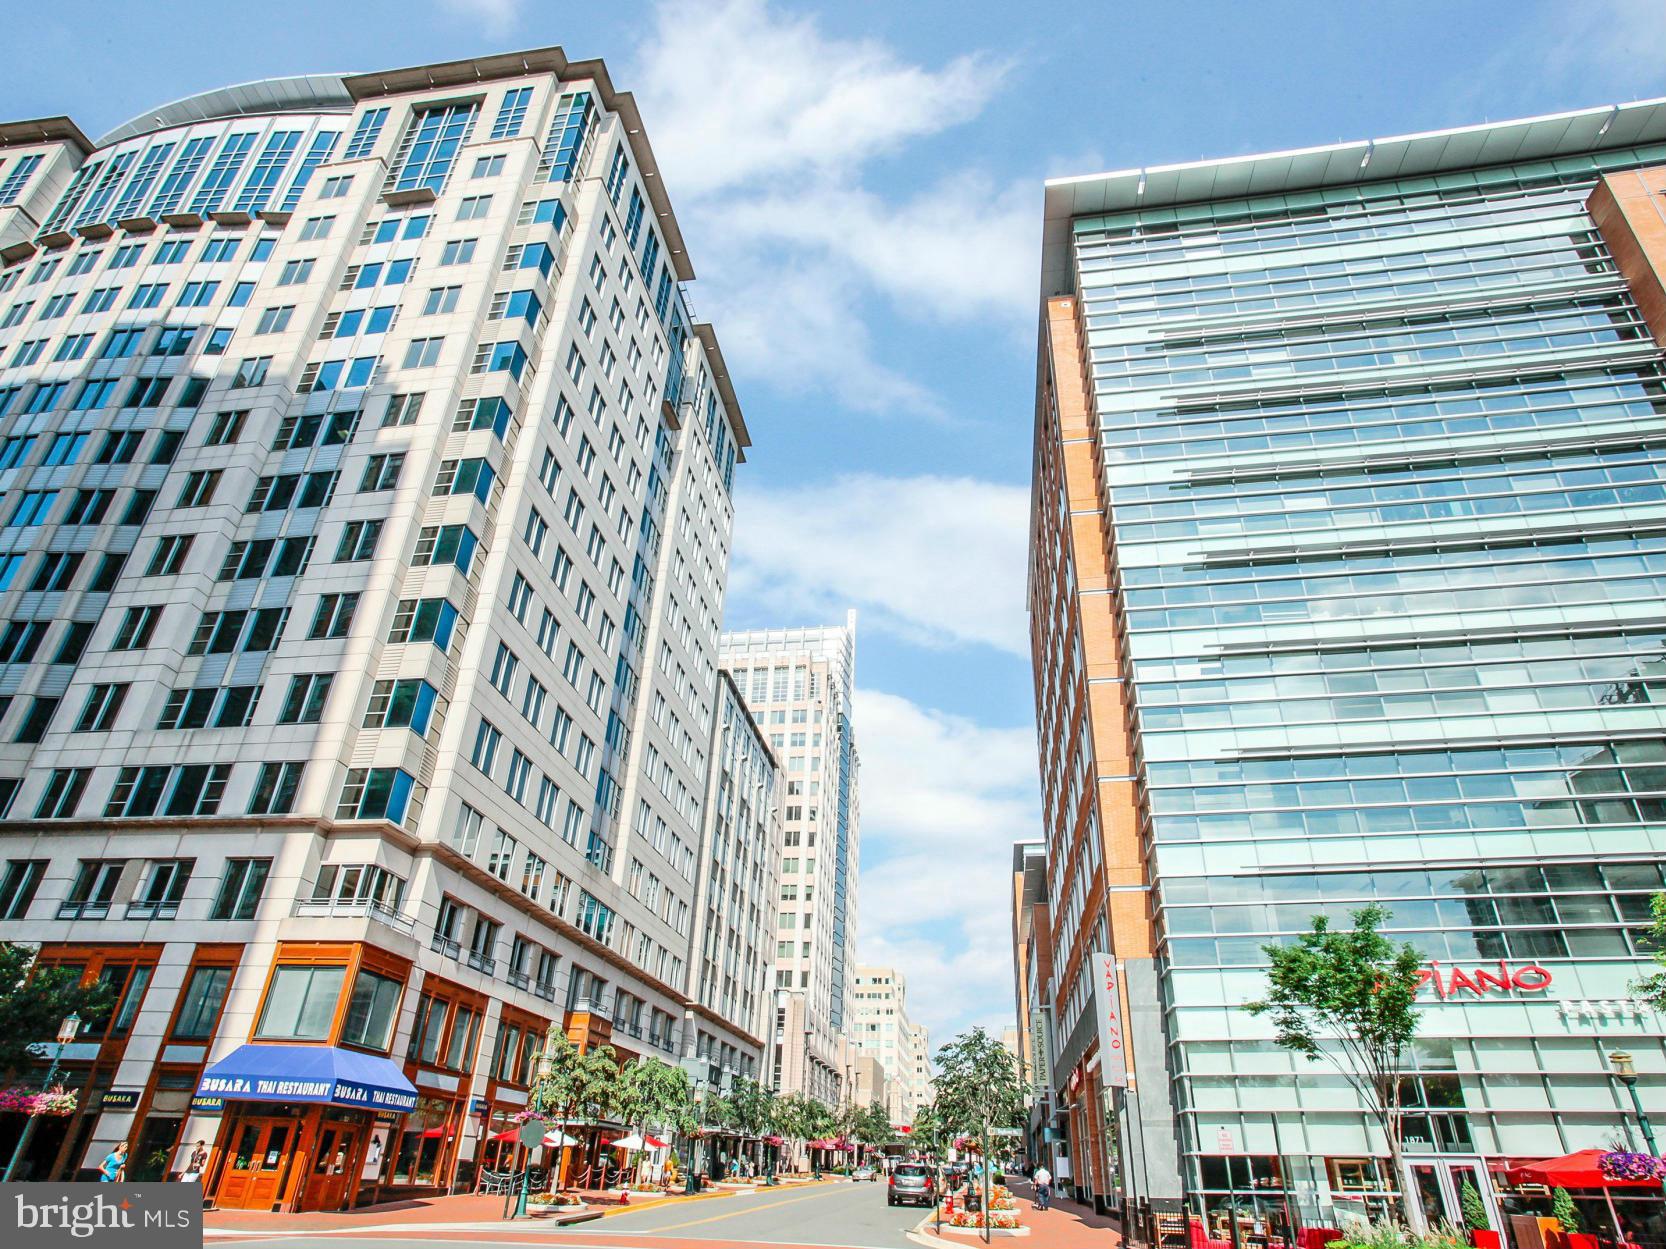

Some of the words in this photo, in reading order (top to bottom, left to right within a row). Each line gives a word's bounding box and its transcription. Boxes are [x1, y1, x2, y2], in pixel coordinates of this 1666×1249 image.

[201, 1078, 251, 1093] BUSARA
[257, 1080, 277, 1094] THAI
[276, 1081, 331, 1097] RESTAURANT
[102, 1094, 132, 1103] BUSARA
[191, 1097, 222, 1106] BUSARA
[334, 1084, 368, 1102] BUSARA
[372, 1090, 386, 1104] THAI
[384, 1093, 415, 1109] RESTAURANT
